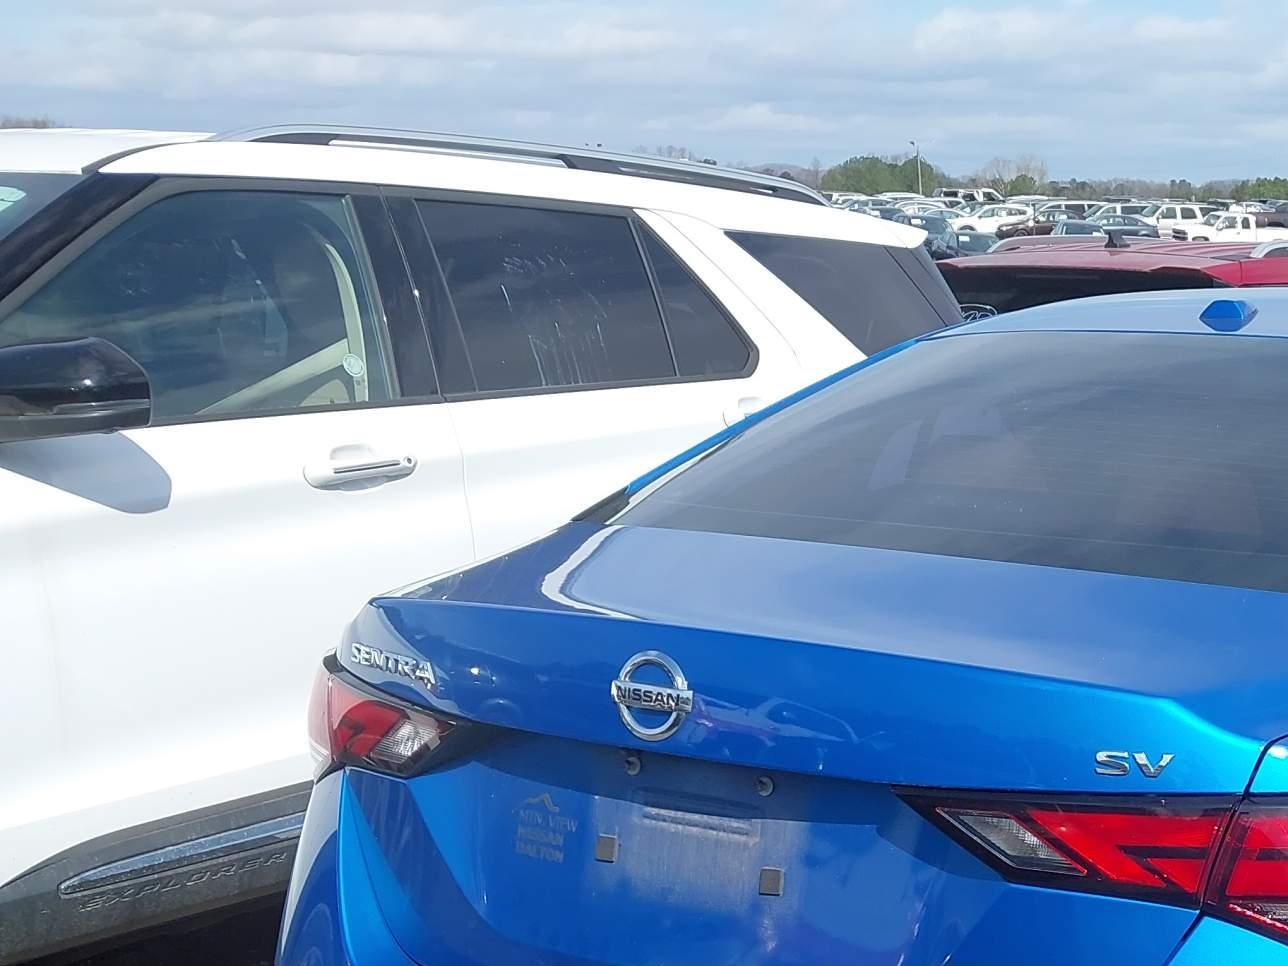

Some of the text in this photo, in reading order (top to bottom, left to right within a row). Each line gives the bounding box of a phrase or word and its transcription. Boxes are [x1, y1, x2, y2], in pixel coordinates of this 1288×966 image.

[351, 642, 436, 686] SENTRA
[616, 685, 680, 707] NISSAN
[1095, 750, 1175, 778] SV
[79, 852, 287, 912] EXPLORER
